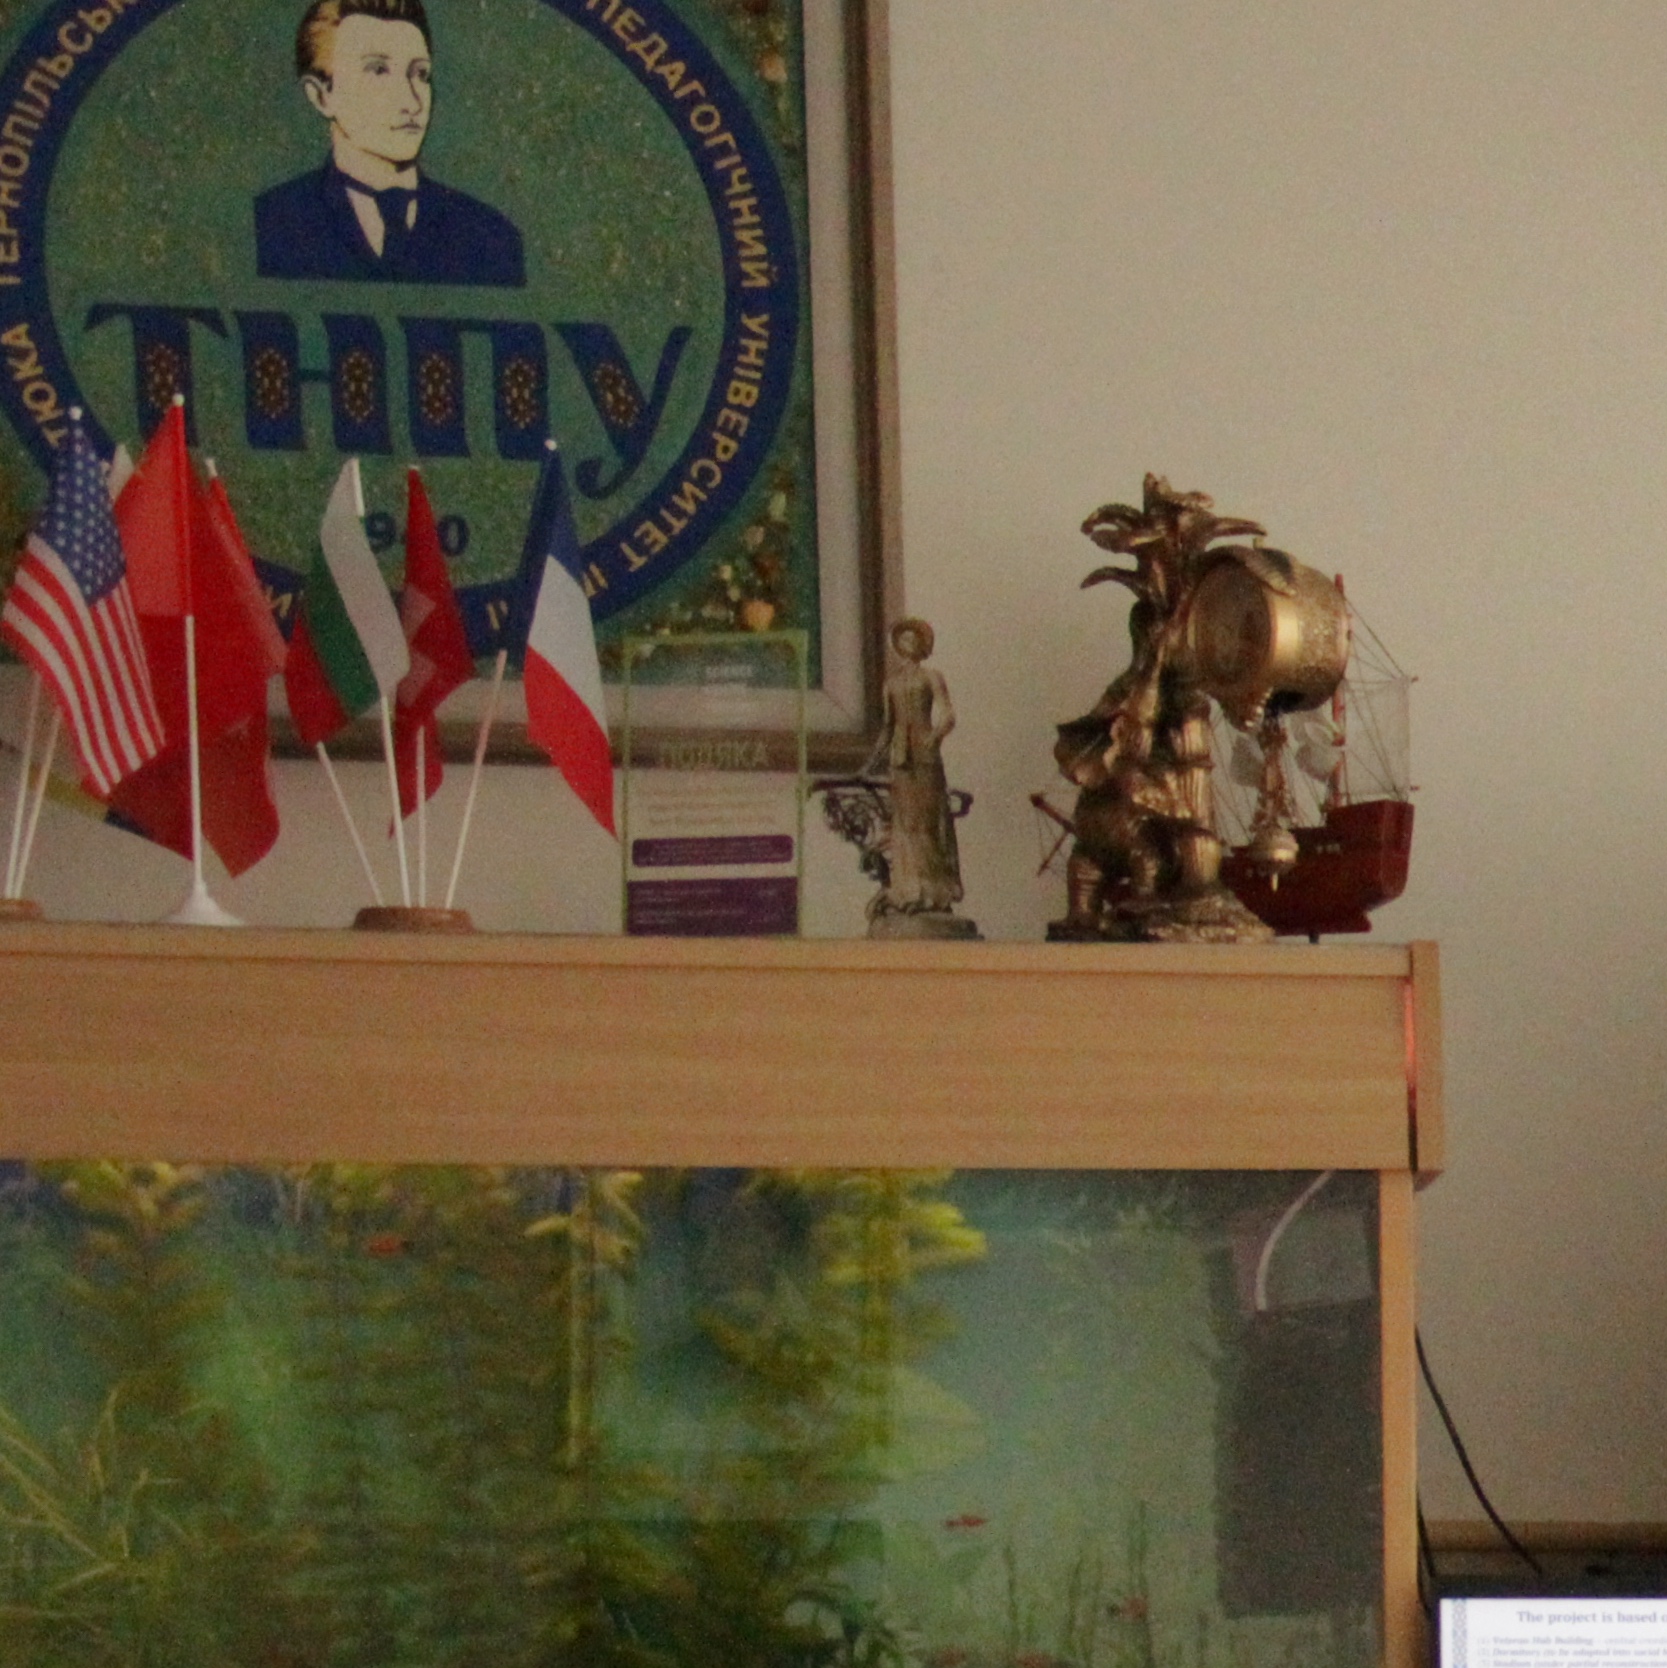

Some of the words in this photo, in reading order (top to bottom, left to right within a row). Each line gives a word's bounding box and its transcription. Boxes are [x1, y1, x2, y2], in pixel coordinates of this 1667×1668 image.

[83, 303, 693, 500] ТНПУ
[620, 313, 770, 572] УНІВЕРСИТЕТ
[1517, 1611, 1543, 1622] The
[1548, 1612, 1596, 1625] project
[1602, 1612, 1612, 1622] is
[1617, 1612, 1657, 1623] based
